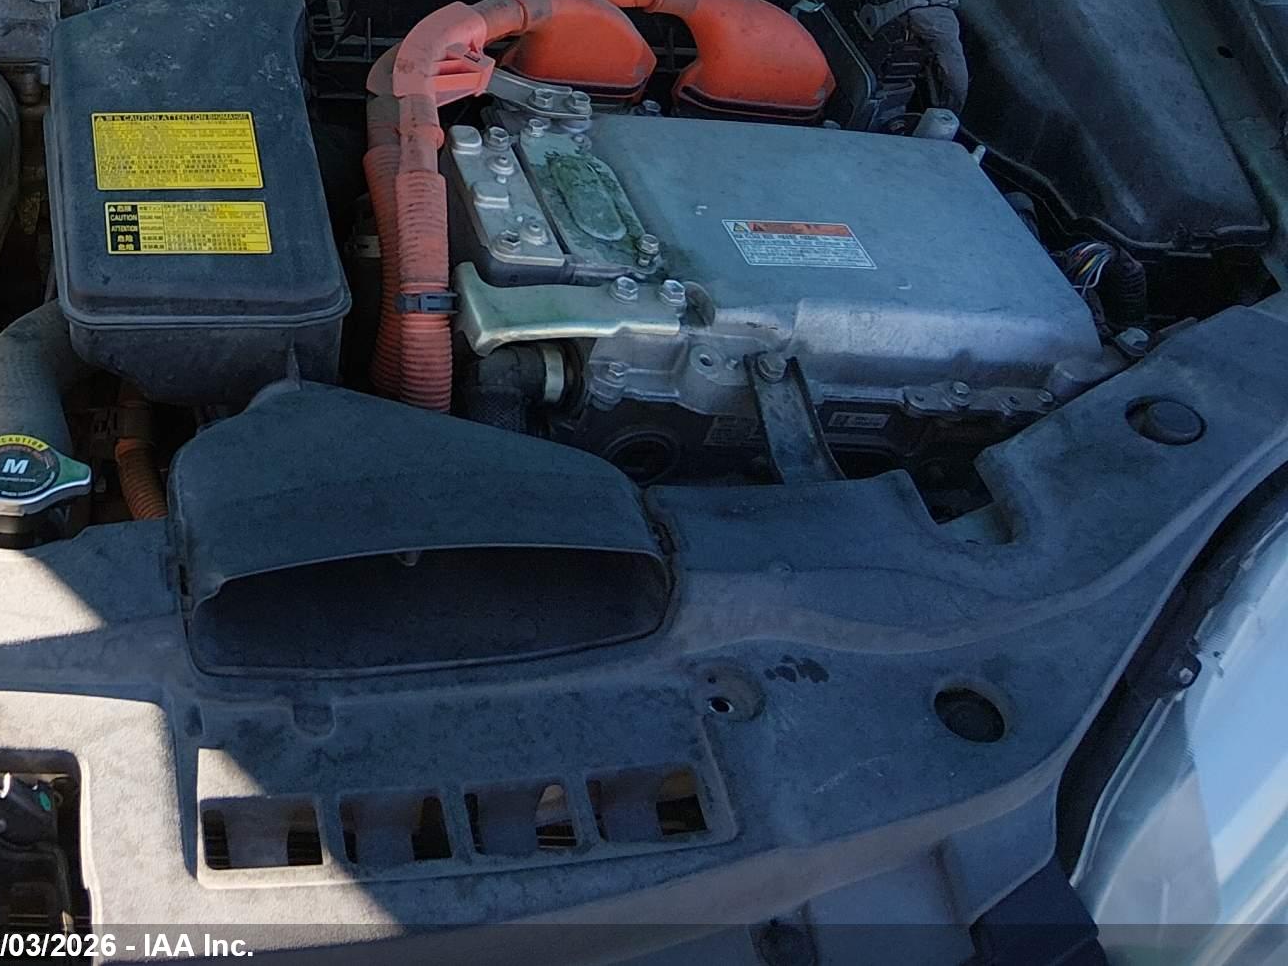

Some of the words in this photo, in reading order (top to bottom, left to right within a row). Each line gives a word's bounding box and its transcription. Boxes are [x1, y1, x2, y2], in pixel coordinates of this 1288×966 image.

[110, 214, 137, 222] CAUTION
[0, 436, 44, 449] CAUTION
[1, 458, 30, 475] M
